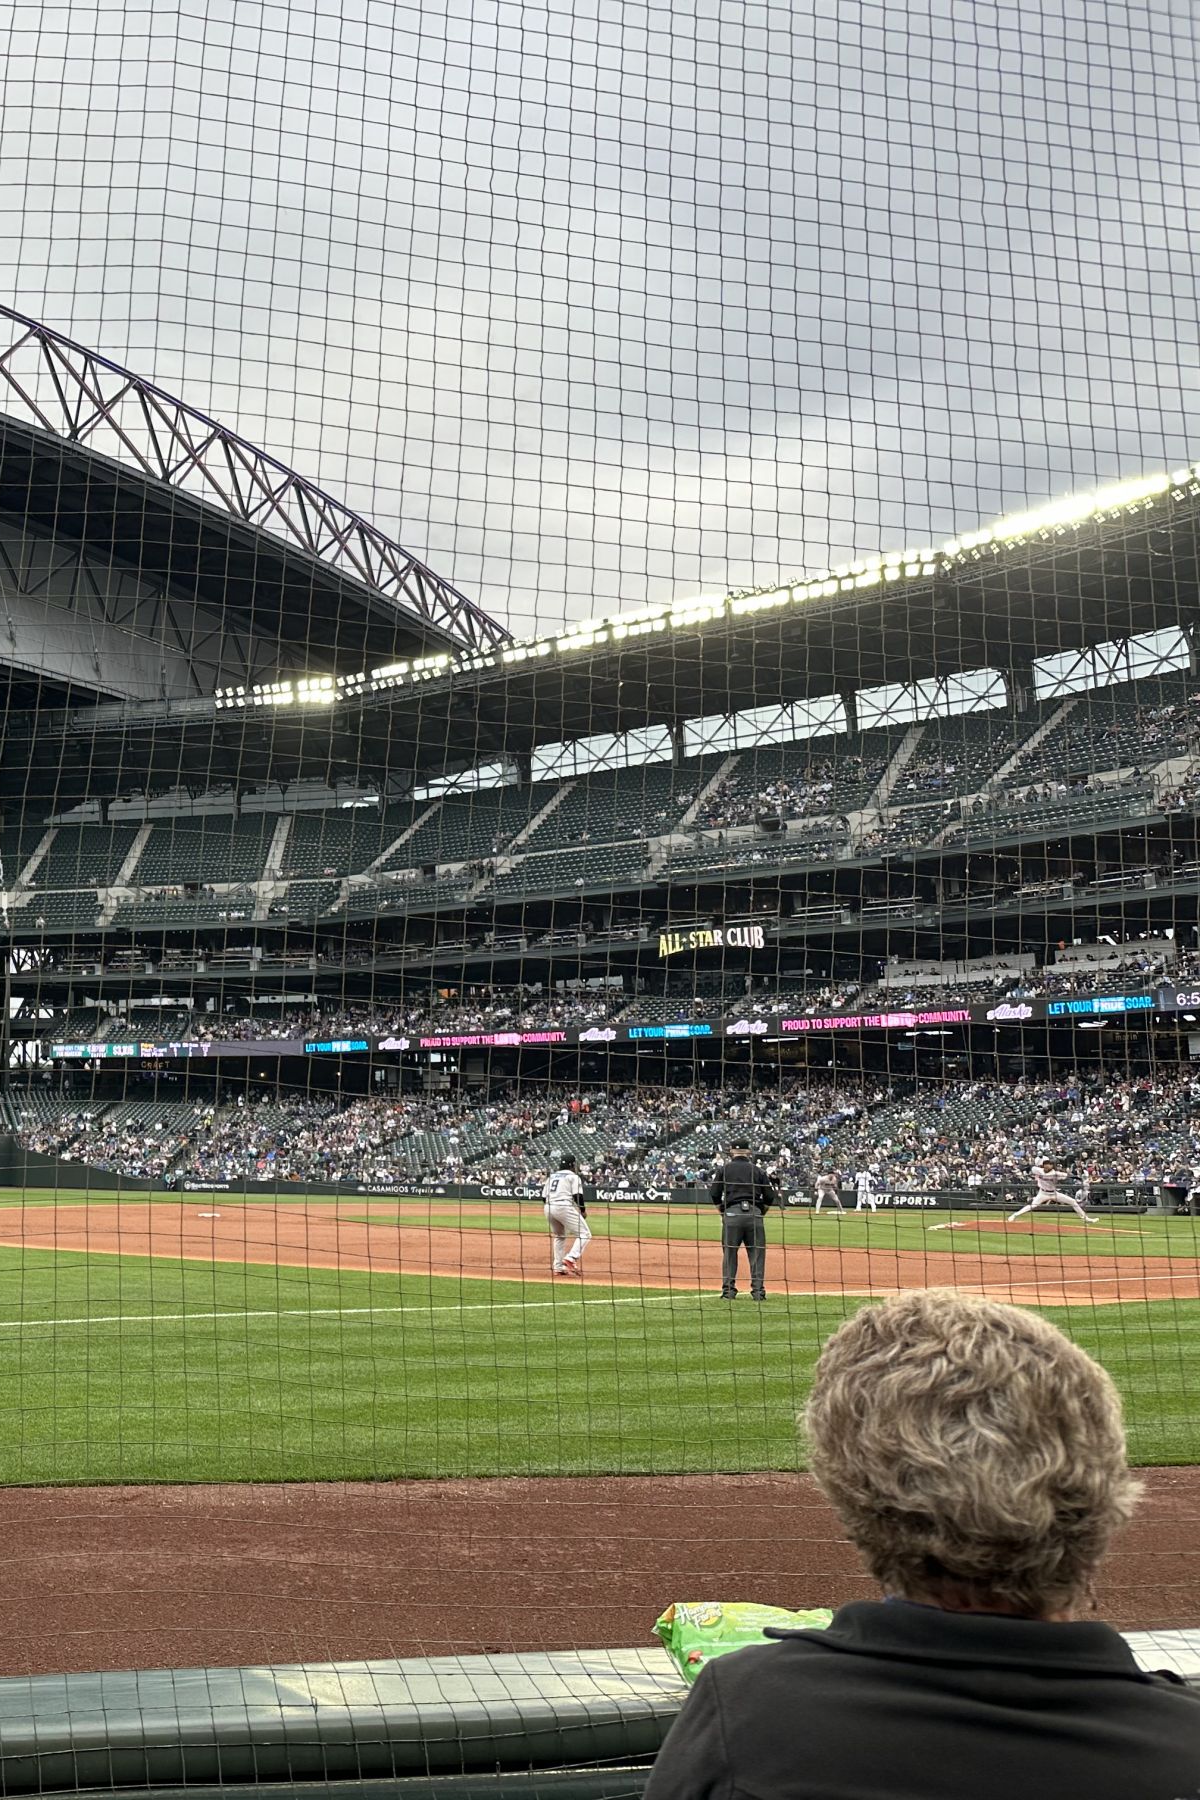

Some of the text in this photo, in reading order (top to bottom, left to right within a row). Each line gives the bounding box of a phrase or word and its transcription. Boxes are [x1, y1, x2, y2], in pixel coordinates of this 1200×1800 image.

[727, 925, 765, 949] CLUB
[986, 1003, 1033, 1020] Alaska
[1048, 996, 1155, 1015] LET YOUR PRIDE SOAR.
[782, 1019, 809, 1031] PROUD
[811, 1018, 822, 1029] TO
[823, 1016, 862, 1029] SUPPORT
[863, 1016, 880, 1027] THE
[918, 1010, 972, 1023] COMMUNITY.
[442, 1037, 451, 1046] TO
[451, 1035, 480, 1046] SUPPORT
[481, 1035, 494, 1045] THE
[522, 1031, 567, 1043] COMMUNITY.
[629, 1027, 641, 1038] LET
[643, 1026, 664, 1037] YOUR
[306, 1043, 316, 1052] LET
[317, 1042, 332, 1051] YOUR
[367, 1184, 409, 1193] CASAMIGOS
[480, 1185, 540, 1199] Great Clips
[550, 1179, 559, 1192] 9
[596, 1189, 644, 1201] KeyBank
[893, 1196, 937, 1205] SPORTS
